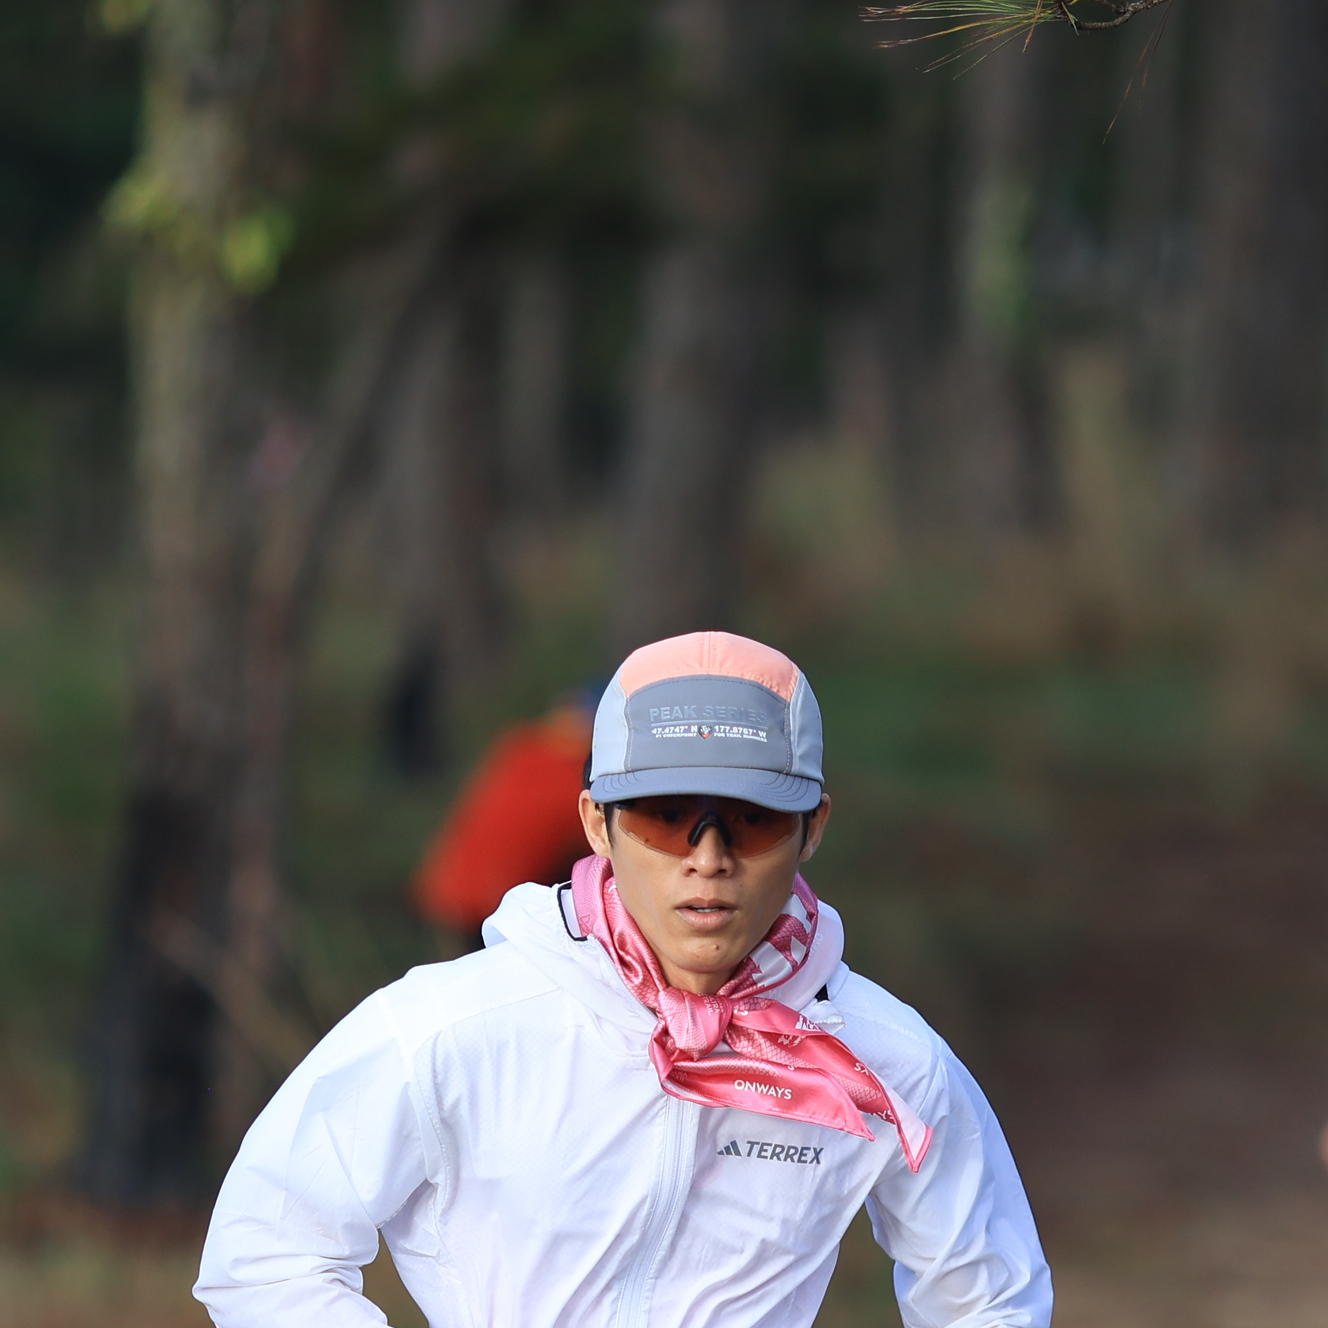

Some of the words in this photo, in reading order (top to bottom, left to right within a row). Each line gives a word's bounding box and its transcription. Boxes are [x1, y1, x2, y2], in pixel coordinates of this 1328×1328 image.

[649, 705, 697, 722] PEAK
[702, 706, 768, 724] SERIES
[691, 725, 698, 733] N
[734, 1079, 793, 1100] ONWAYS
[746, 1140, 824, 1165] TERREX
